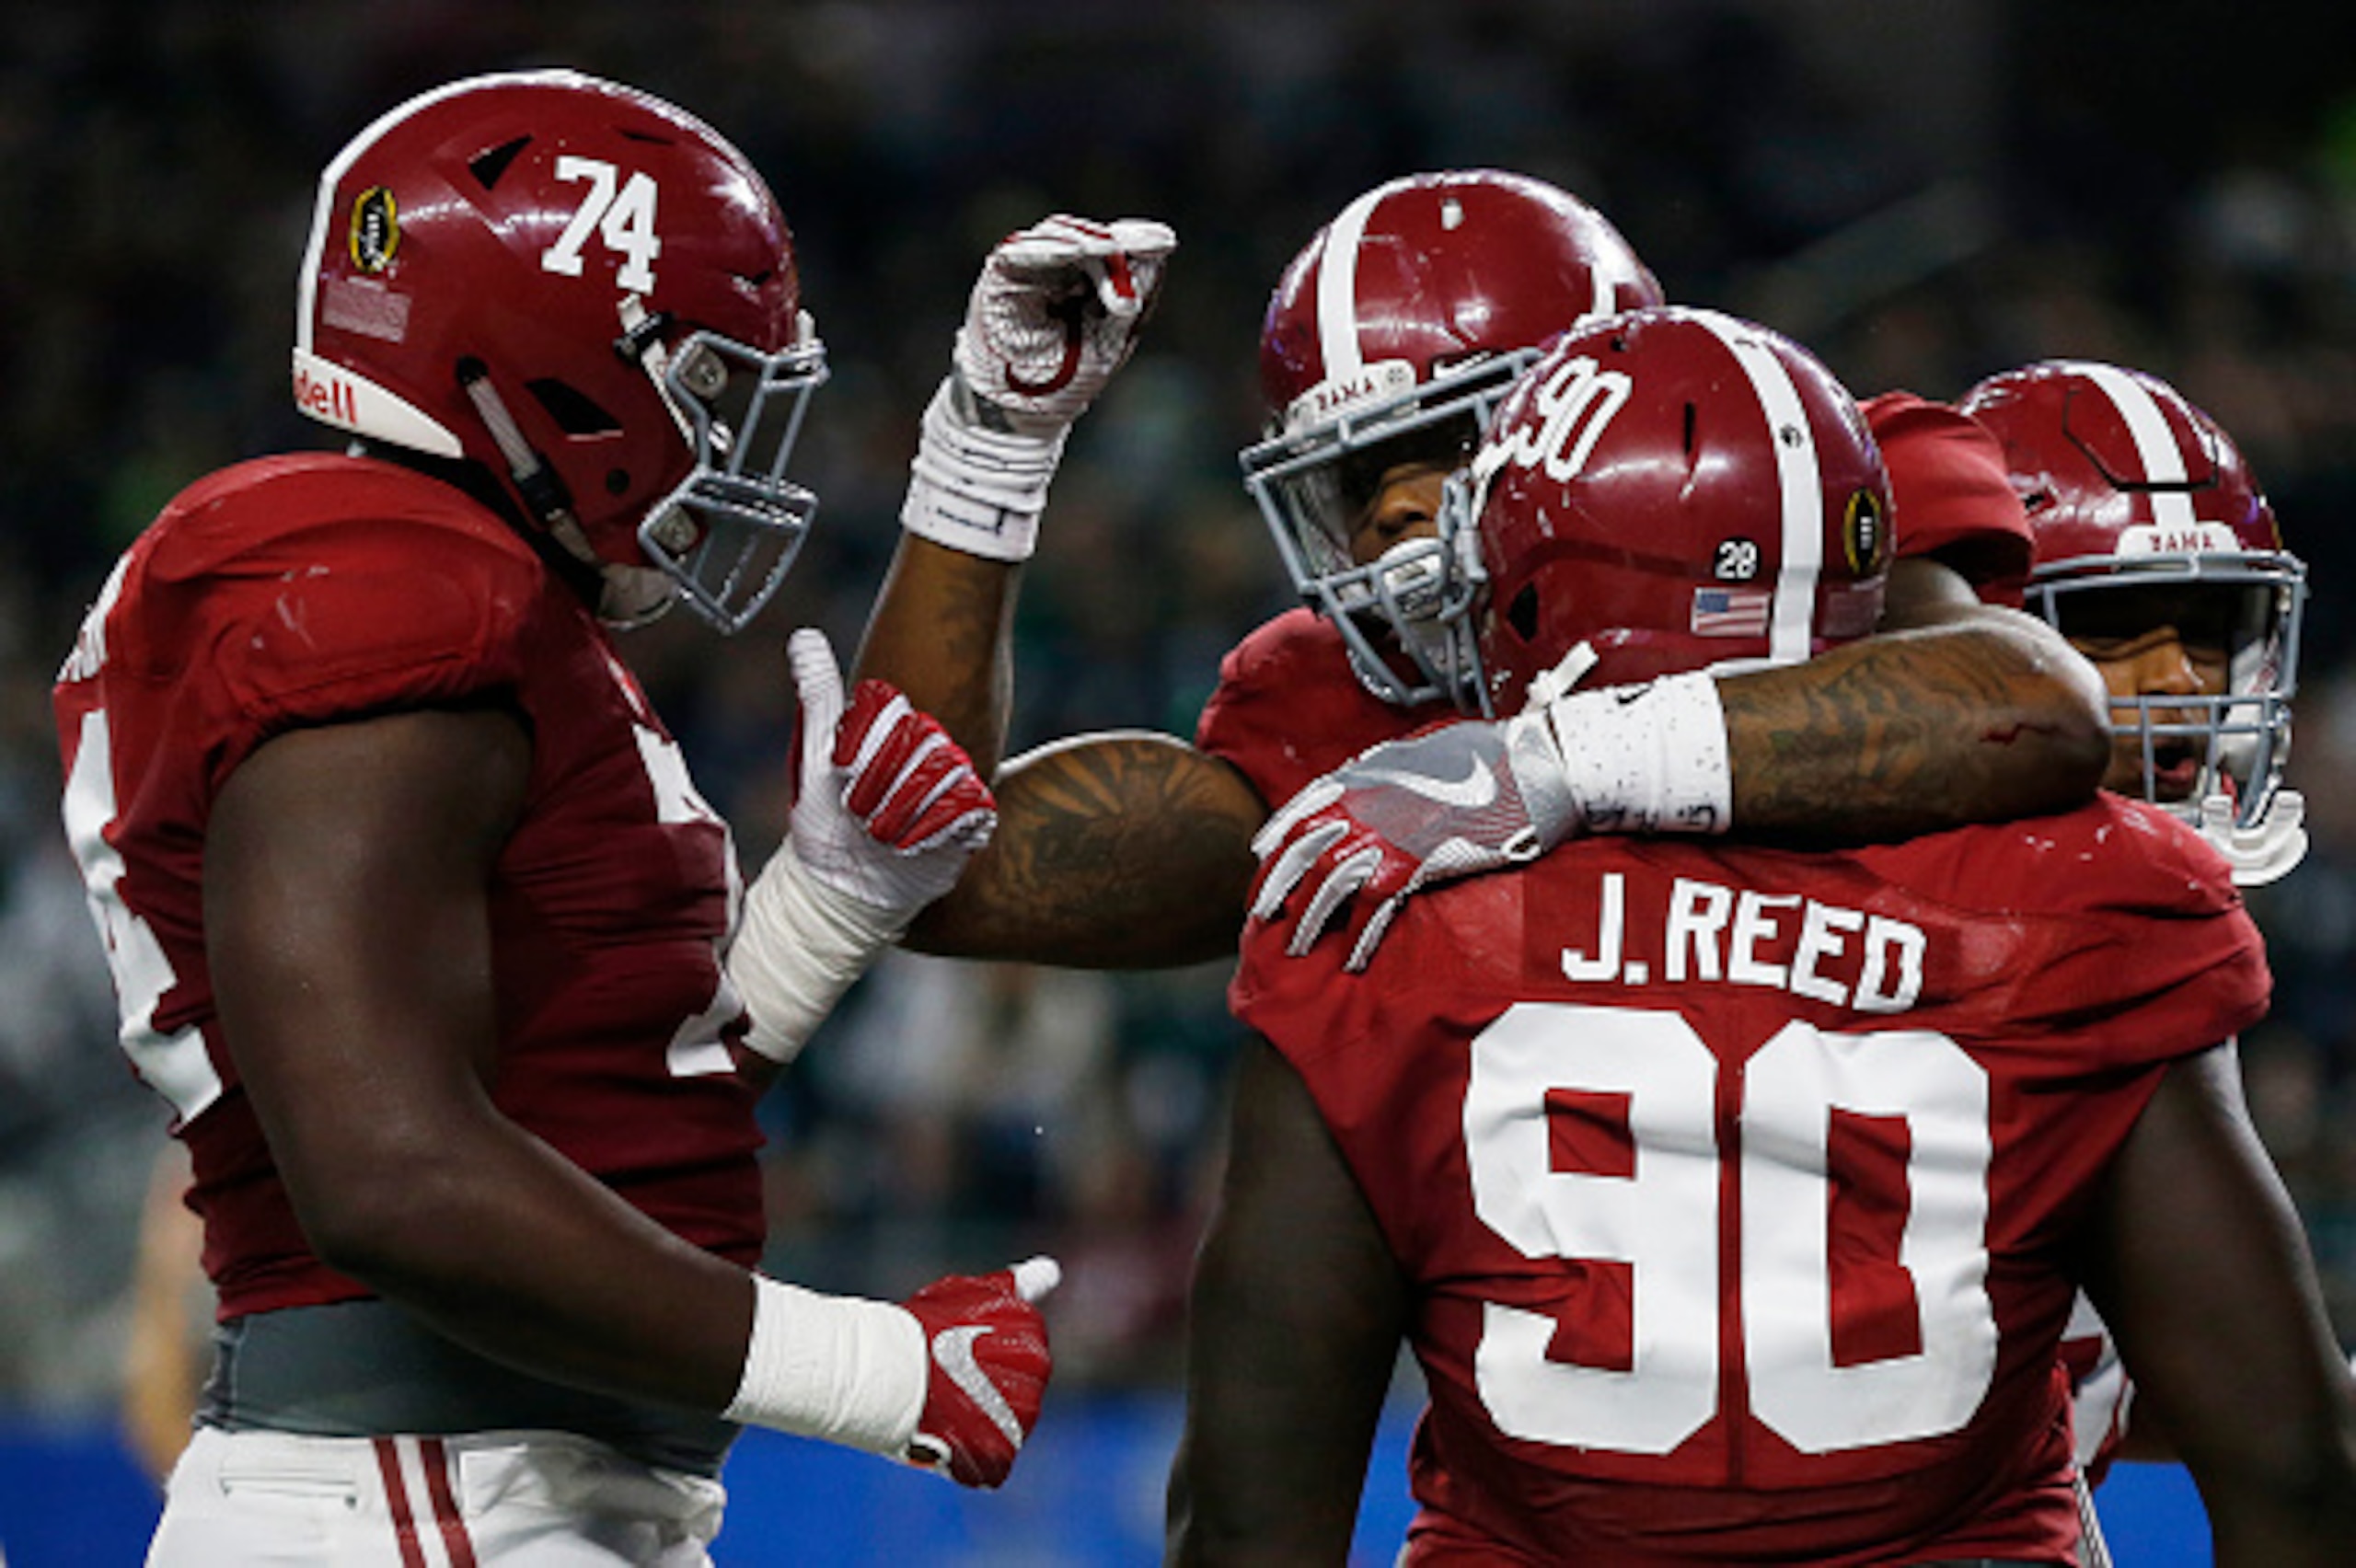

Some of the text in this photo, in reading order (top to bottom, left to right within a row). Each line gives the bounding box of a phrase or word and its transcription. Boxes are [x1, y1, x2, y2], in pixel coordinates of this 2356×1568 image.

[541, 156, 661, 294] 74
[1514, 355, 1634, 483] 90
[1461, 1001, 2000, 1456] 90
